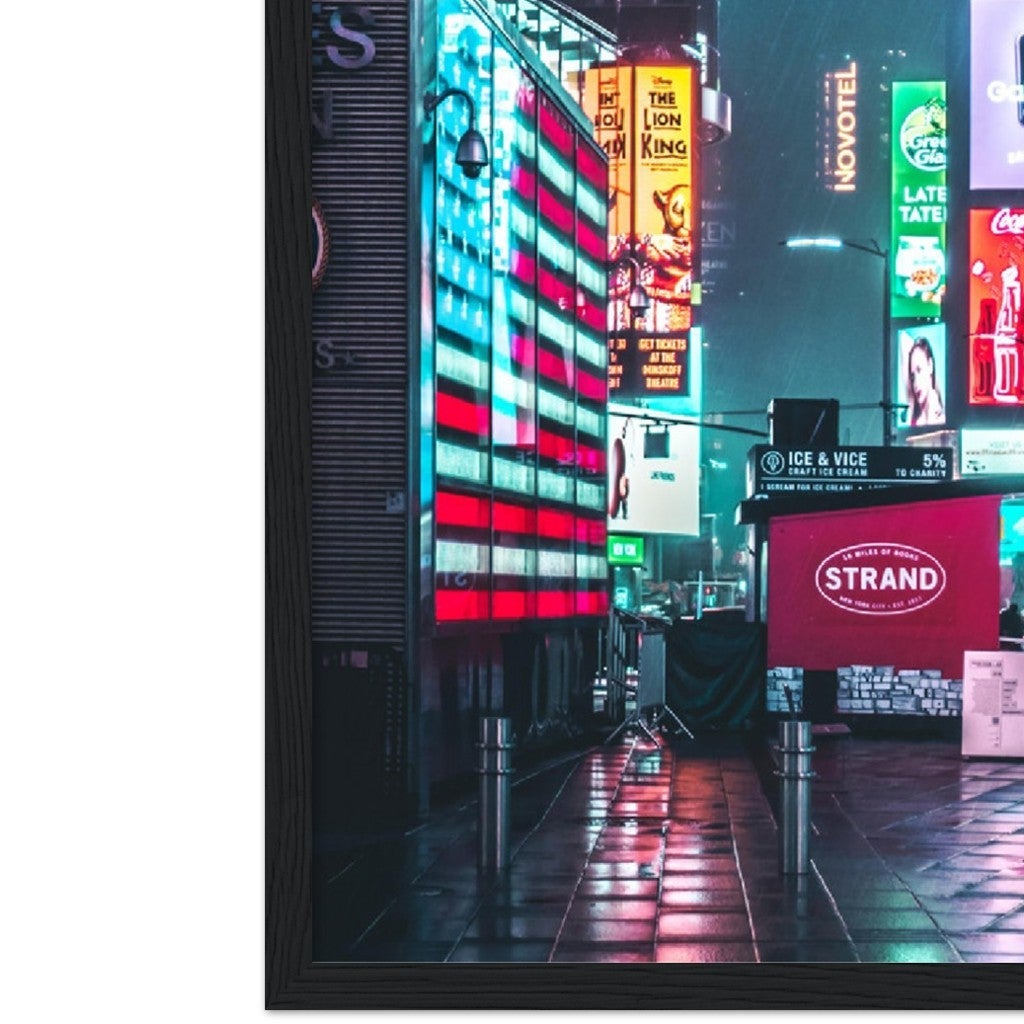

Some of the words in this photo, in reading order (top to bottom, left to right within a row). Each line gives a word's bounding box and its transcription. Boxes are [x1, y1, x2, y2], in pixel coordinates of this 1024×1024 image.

[648, 92, 676, 105] THE
[834, 62, 856, 190] NOVOTEL
[649, 352, 660, 363] AT
[661, 352, 676, 363] THE
[788, 451, 813, 466] ICE
[818, 452, 829, 466] &
[834, 451, 867, 467] VICE
[923, 453, 947, 468] 5%
[788, 467, 816, 476] CRAFT
[819, 468, 833, 476] ICE
[836, 468, 868, 476] CREAM
[895, 468, 906, 477] TO
[910, 468, 947, 477] CHARITY
[855, 549, 878, 558] MILES
[894, 550, 919, 561] BOOKS
[825, 567, 939, 590] STRAND
